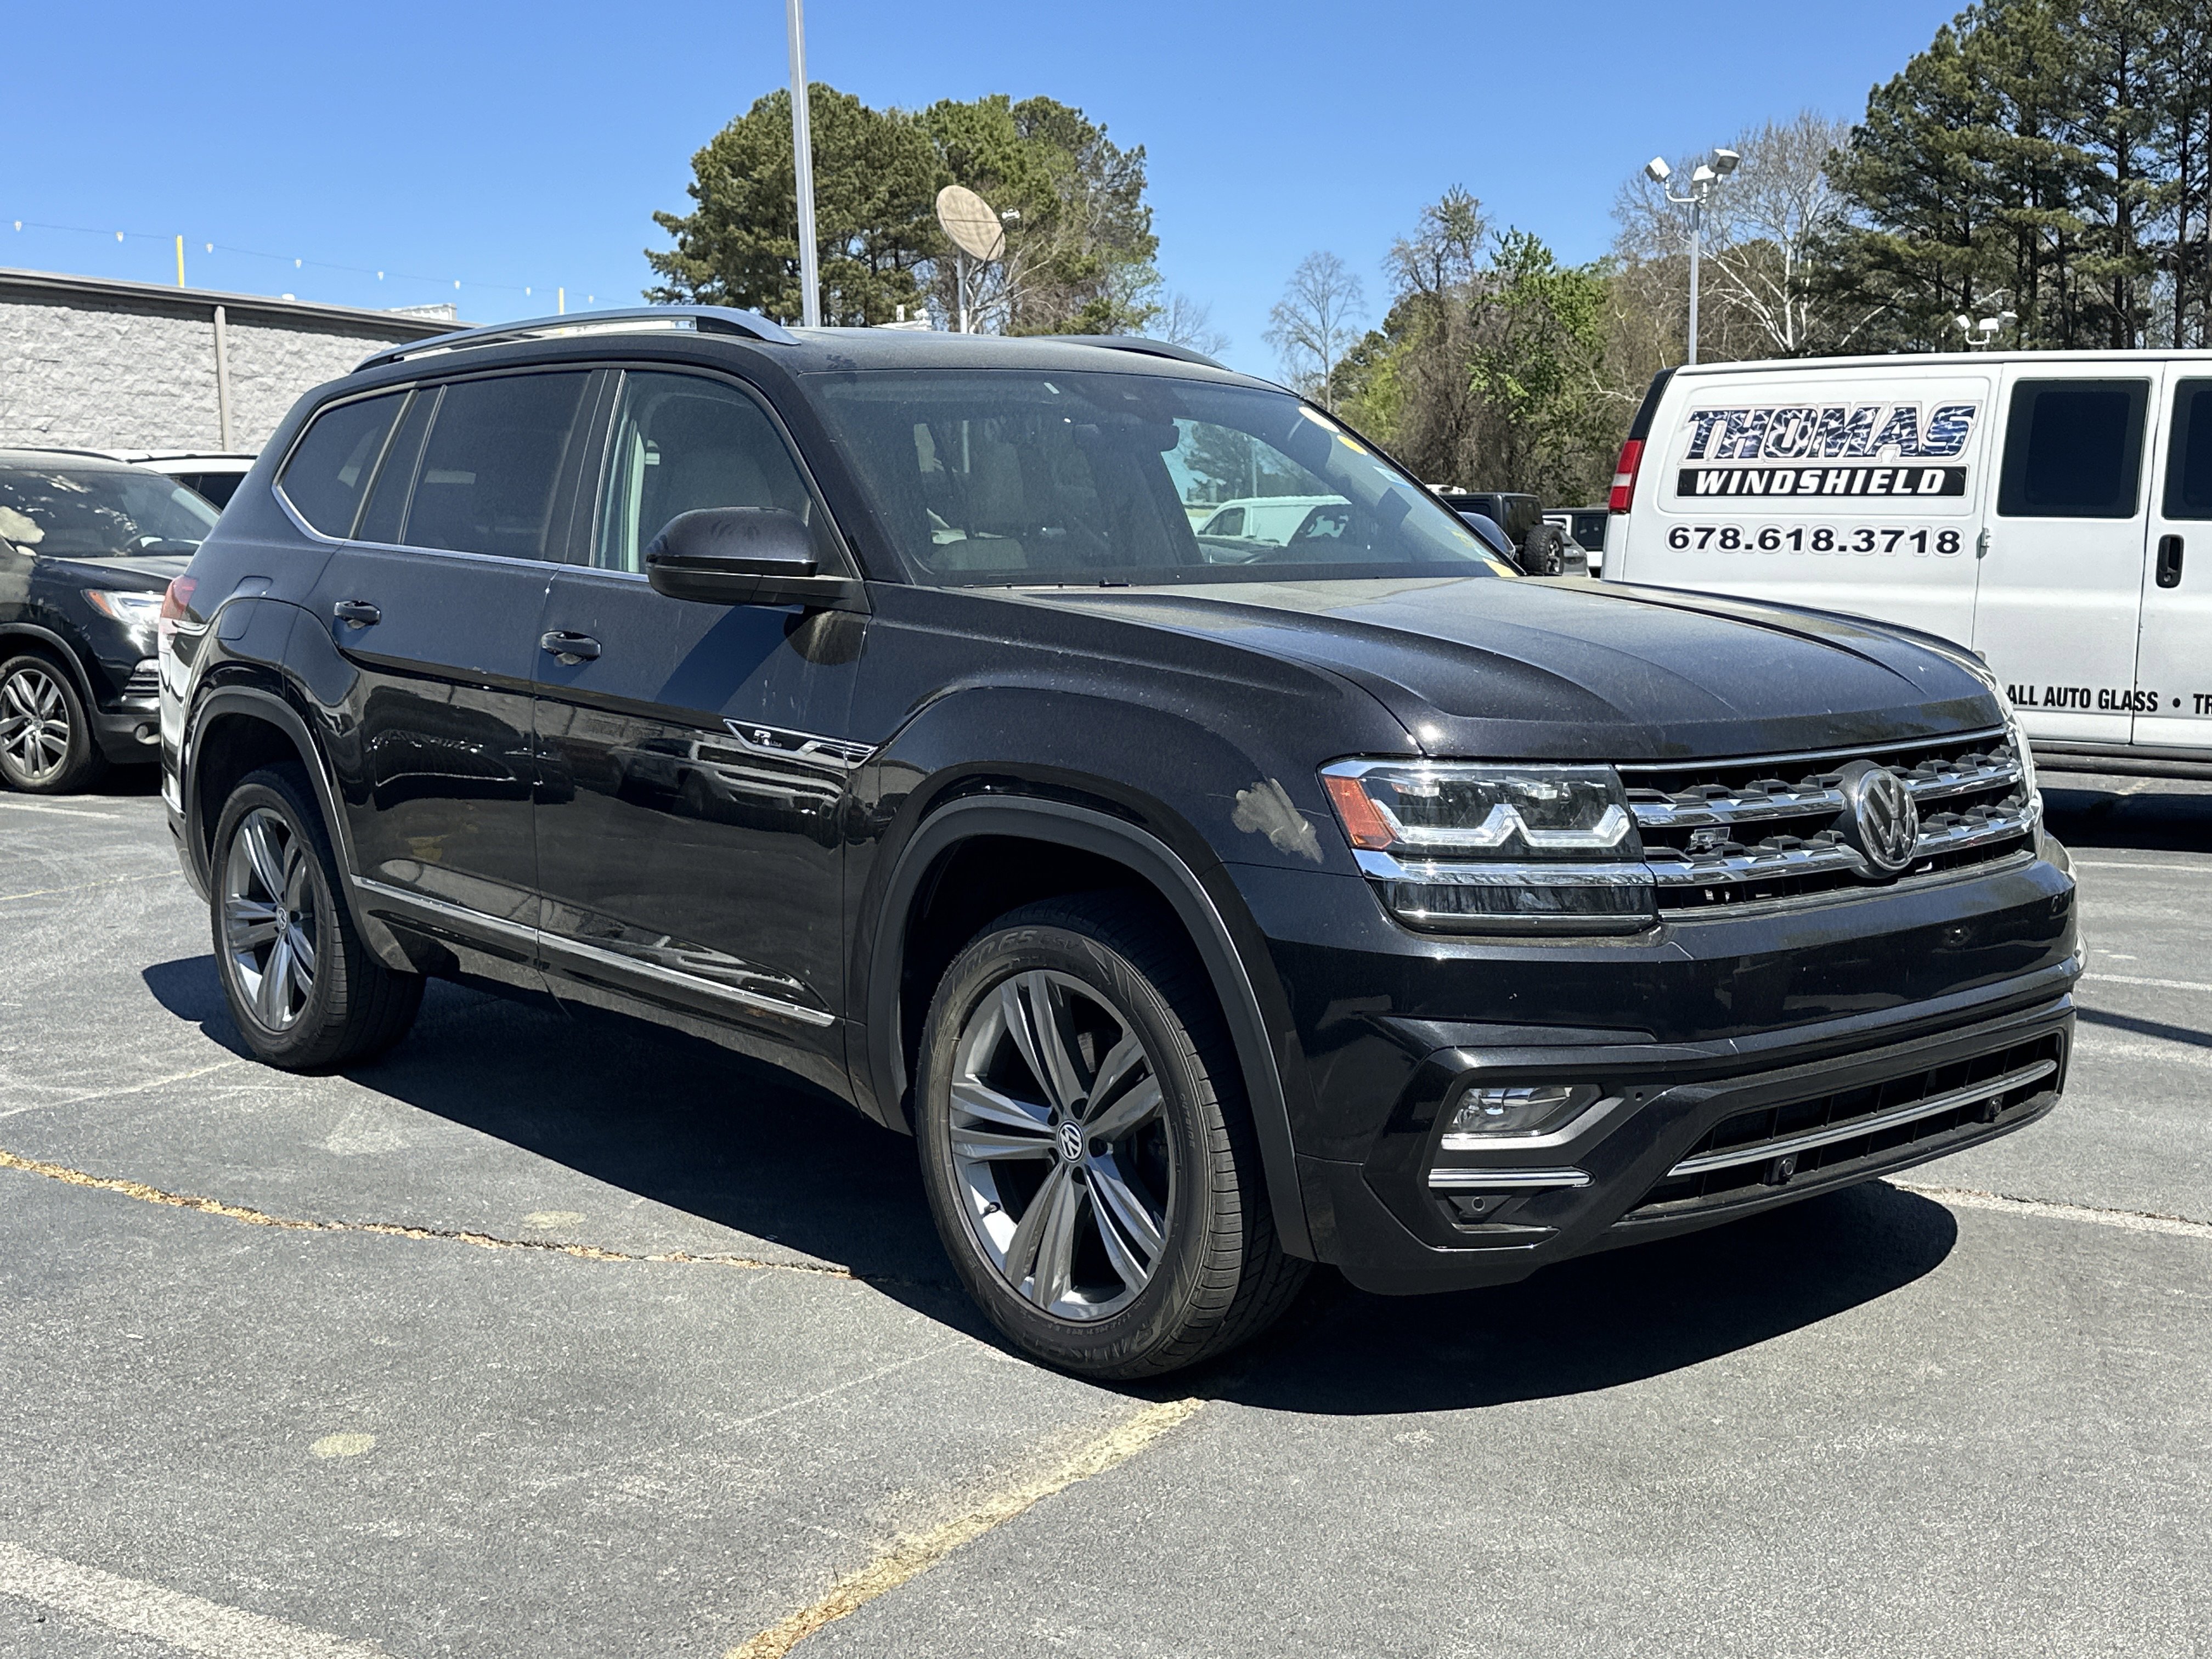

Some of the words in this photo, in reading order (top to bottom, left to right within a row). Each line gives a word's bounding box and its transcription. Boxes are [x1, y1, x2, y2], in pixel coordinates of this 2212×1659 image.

[1685, 406, 1976, 460] THOMAS
[1696, 469, 1945, 494] WINDSHIELD
[1669, 527, 1960, 554] 678.618.3718
[2006, 684, 2038, 706] ALL
[2042, 686, 2091, 708] AUTO
[2097, 689, 2159, 712] GLASS
